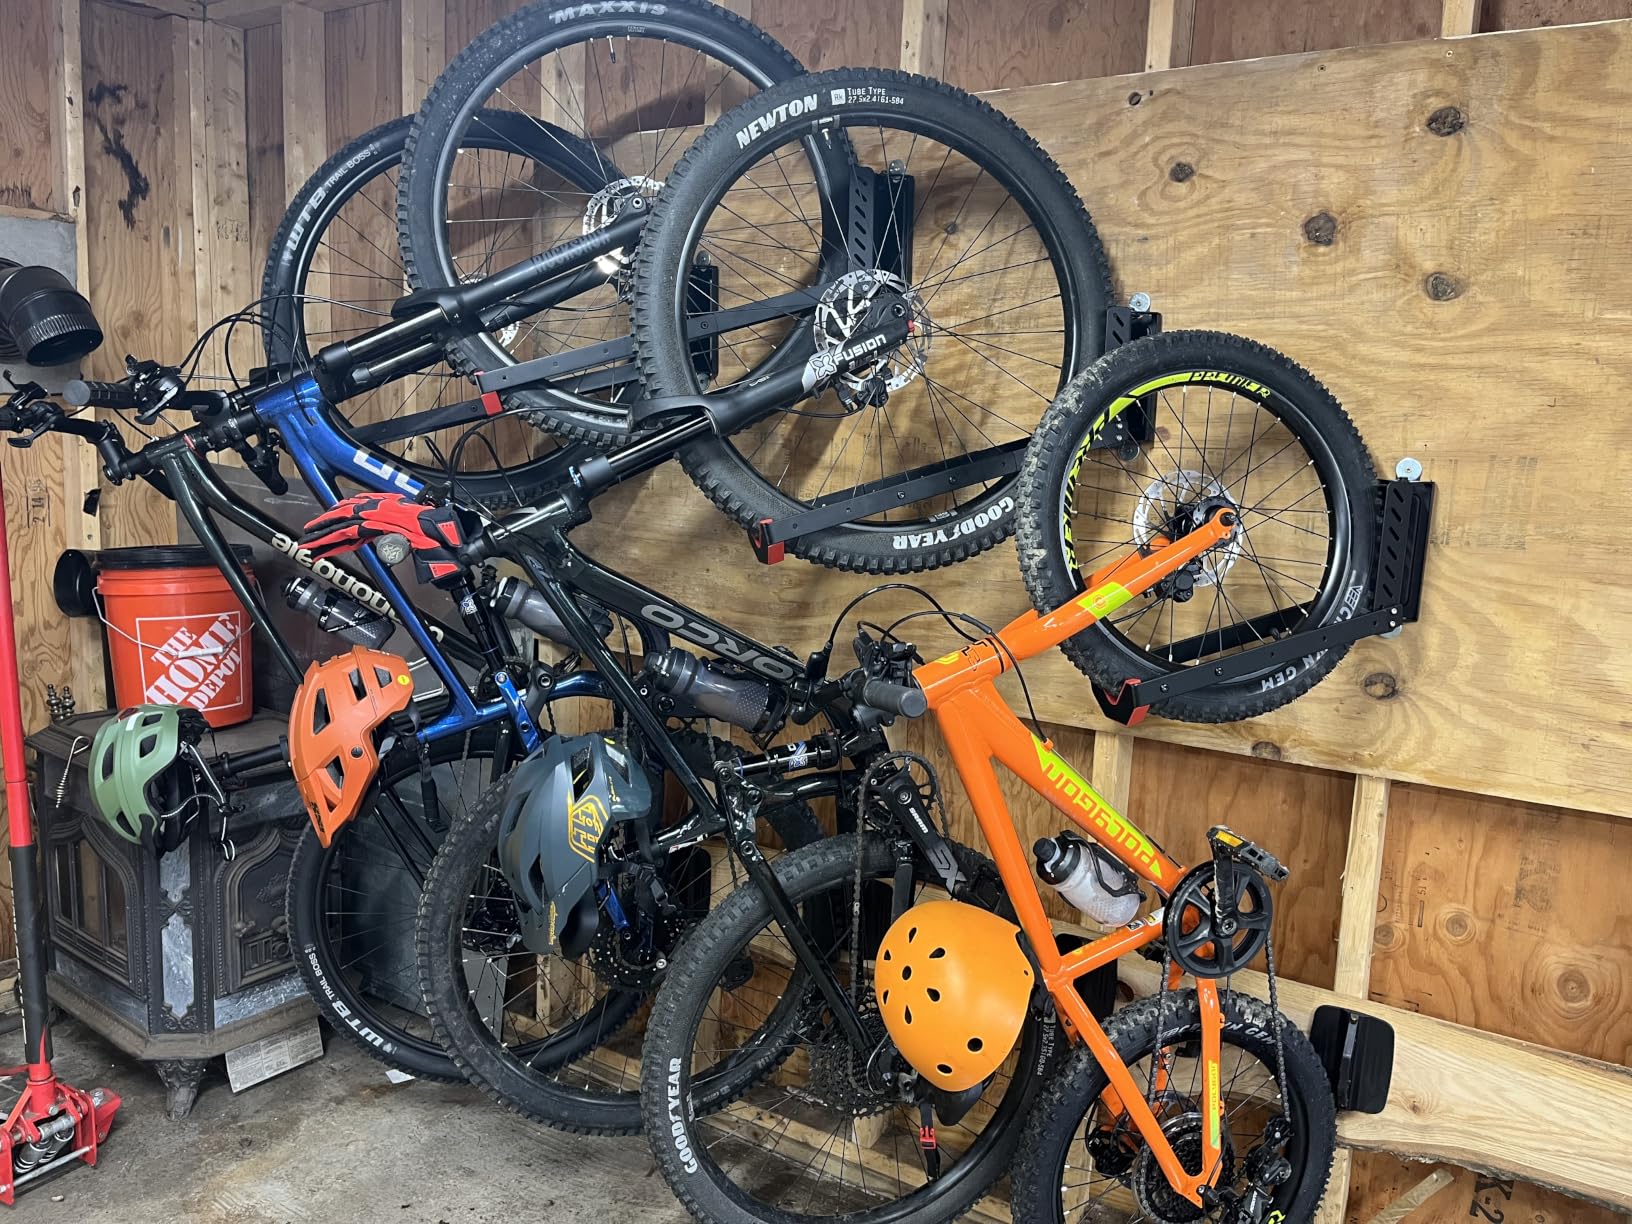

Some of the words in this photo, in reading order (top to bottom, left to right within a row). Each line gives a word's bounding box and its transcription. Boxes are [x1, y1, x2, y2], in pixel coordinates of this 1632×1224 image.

[555, 1, 668, 24] MAXXIS
[735, 93, 818, 149] NEWTON
[286, 186, 327, 251] WTB
[324, 167, 349, 189] TRAIL
[347, 148, 372, 170] BOSS
[833, 334, 887, 366] FUSION
[892, 496, 1015, 550] GOODYEAR
[145, 613, 241, 705] HOME
[150, 626, 198, 668] THE
[640, 604, 795, 681] ORCO
[186, 646, 241, 711] DEPOT
[1261, 666, 1298, 692] GEM
[908, 807, 930, 834] SRAM
[308, 952, 323, 977] BOSS
[319, 976, 336, 1001] TRAIL
[331, 1000, 385, 1048] WTB
[667, 1057, 699, 1174] GOODYEAR
